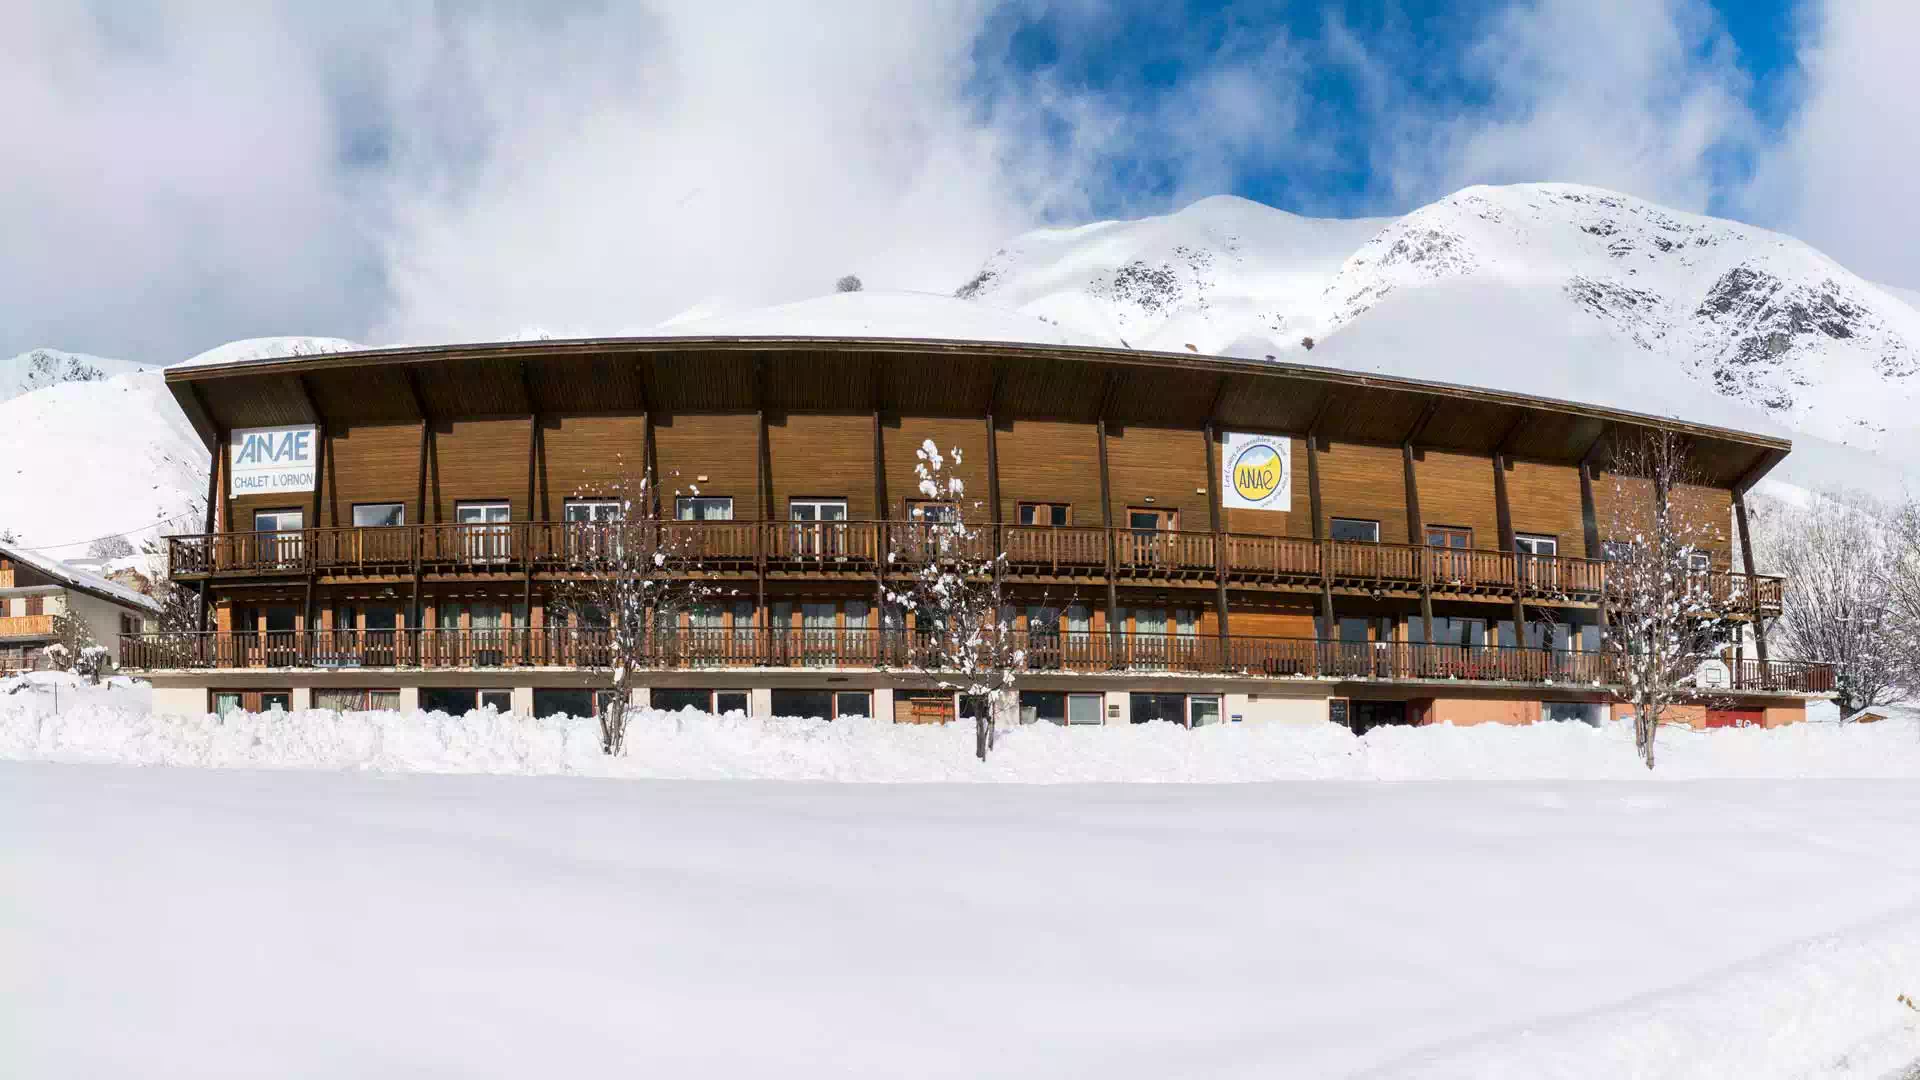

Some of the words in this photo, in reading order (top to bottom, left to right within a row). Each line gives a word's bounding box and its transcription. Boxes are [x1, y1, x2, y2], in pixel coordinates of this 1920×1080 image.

[236, 432, 311, 464] ANAE
[235, 476, 270, 488] CHALET
[272, 473, 313, 487] L'ORNON
